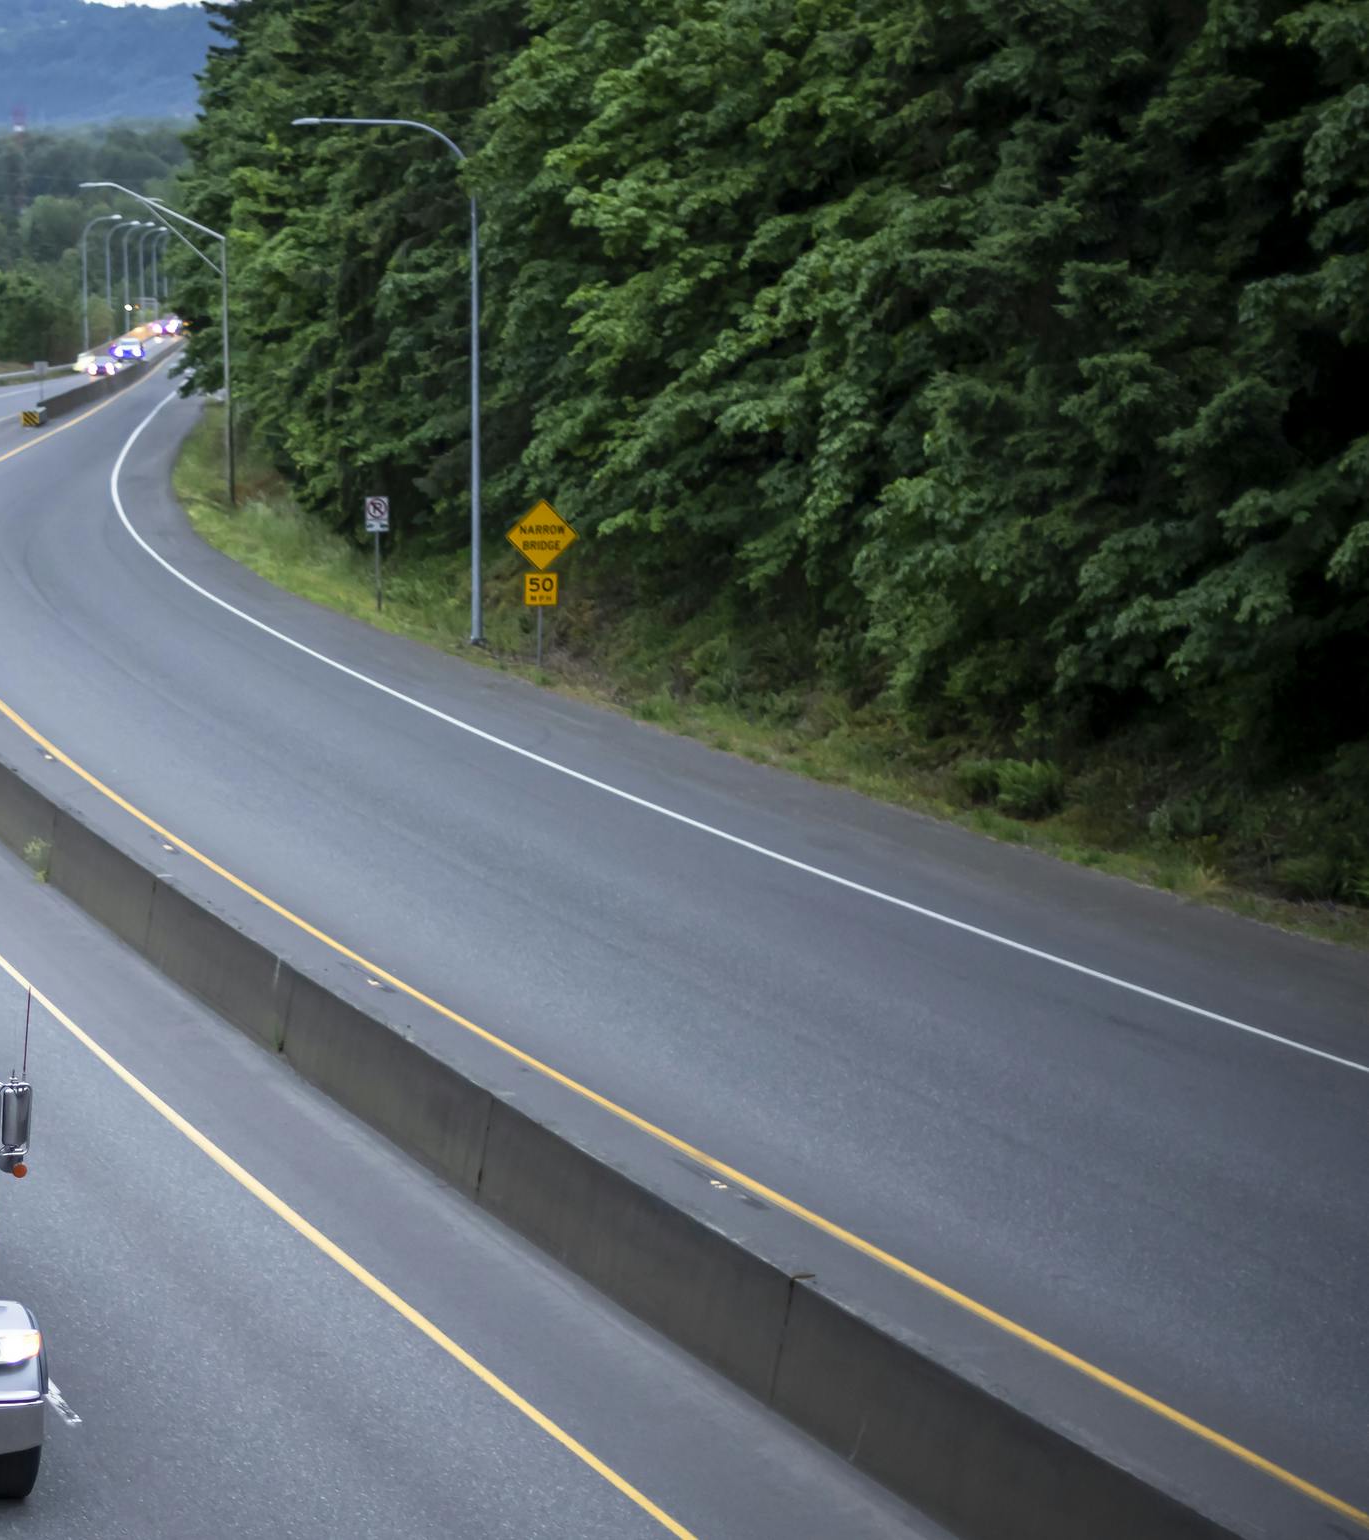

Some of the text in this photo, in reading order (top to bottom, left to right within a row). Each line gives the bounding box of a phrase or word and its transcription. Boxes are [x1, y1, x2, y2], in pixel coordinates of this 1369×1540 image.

[519, 525, 565, 535] NARROW
[522, 540, 561, 551] BRIDGE
[529, 577, 554, 592] 50
